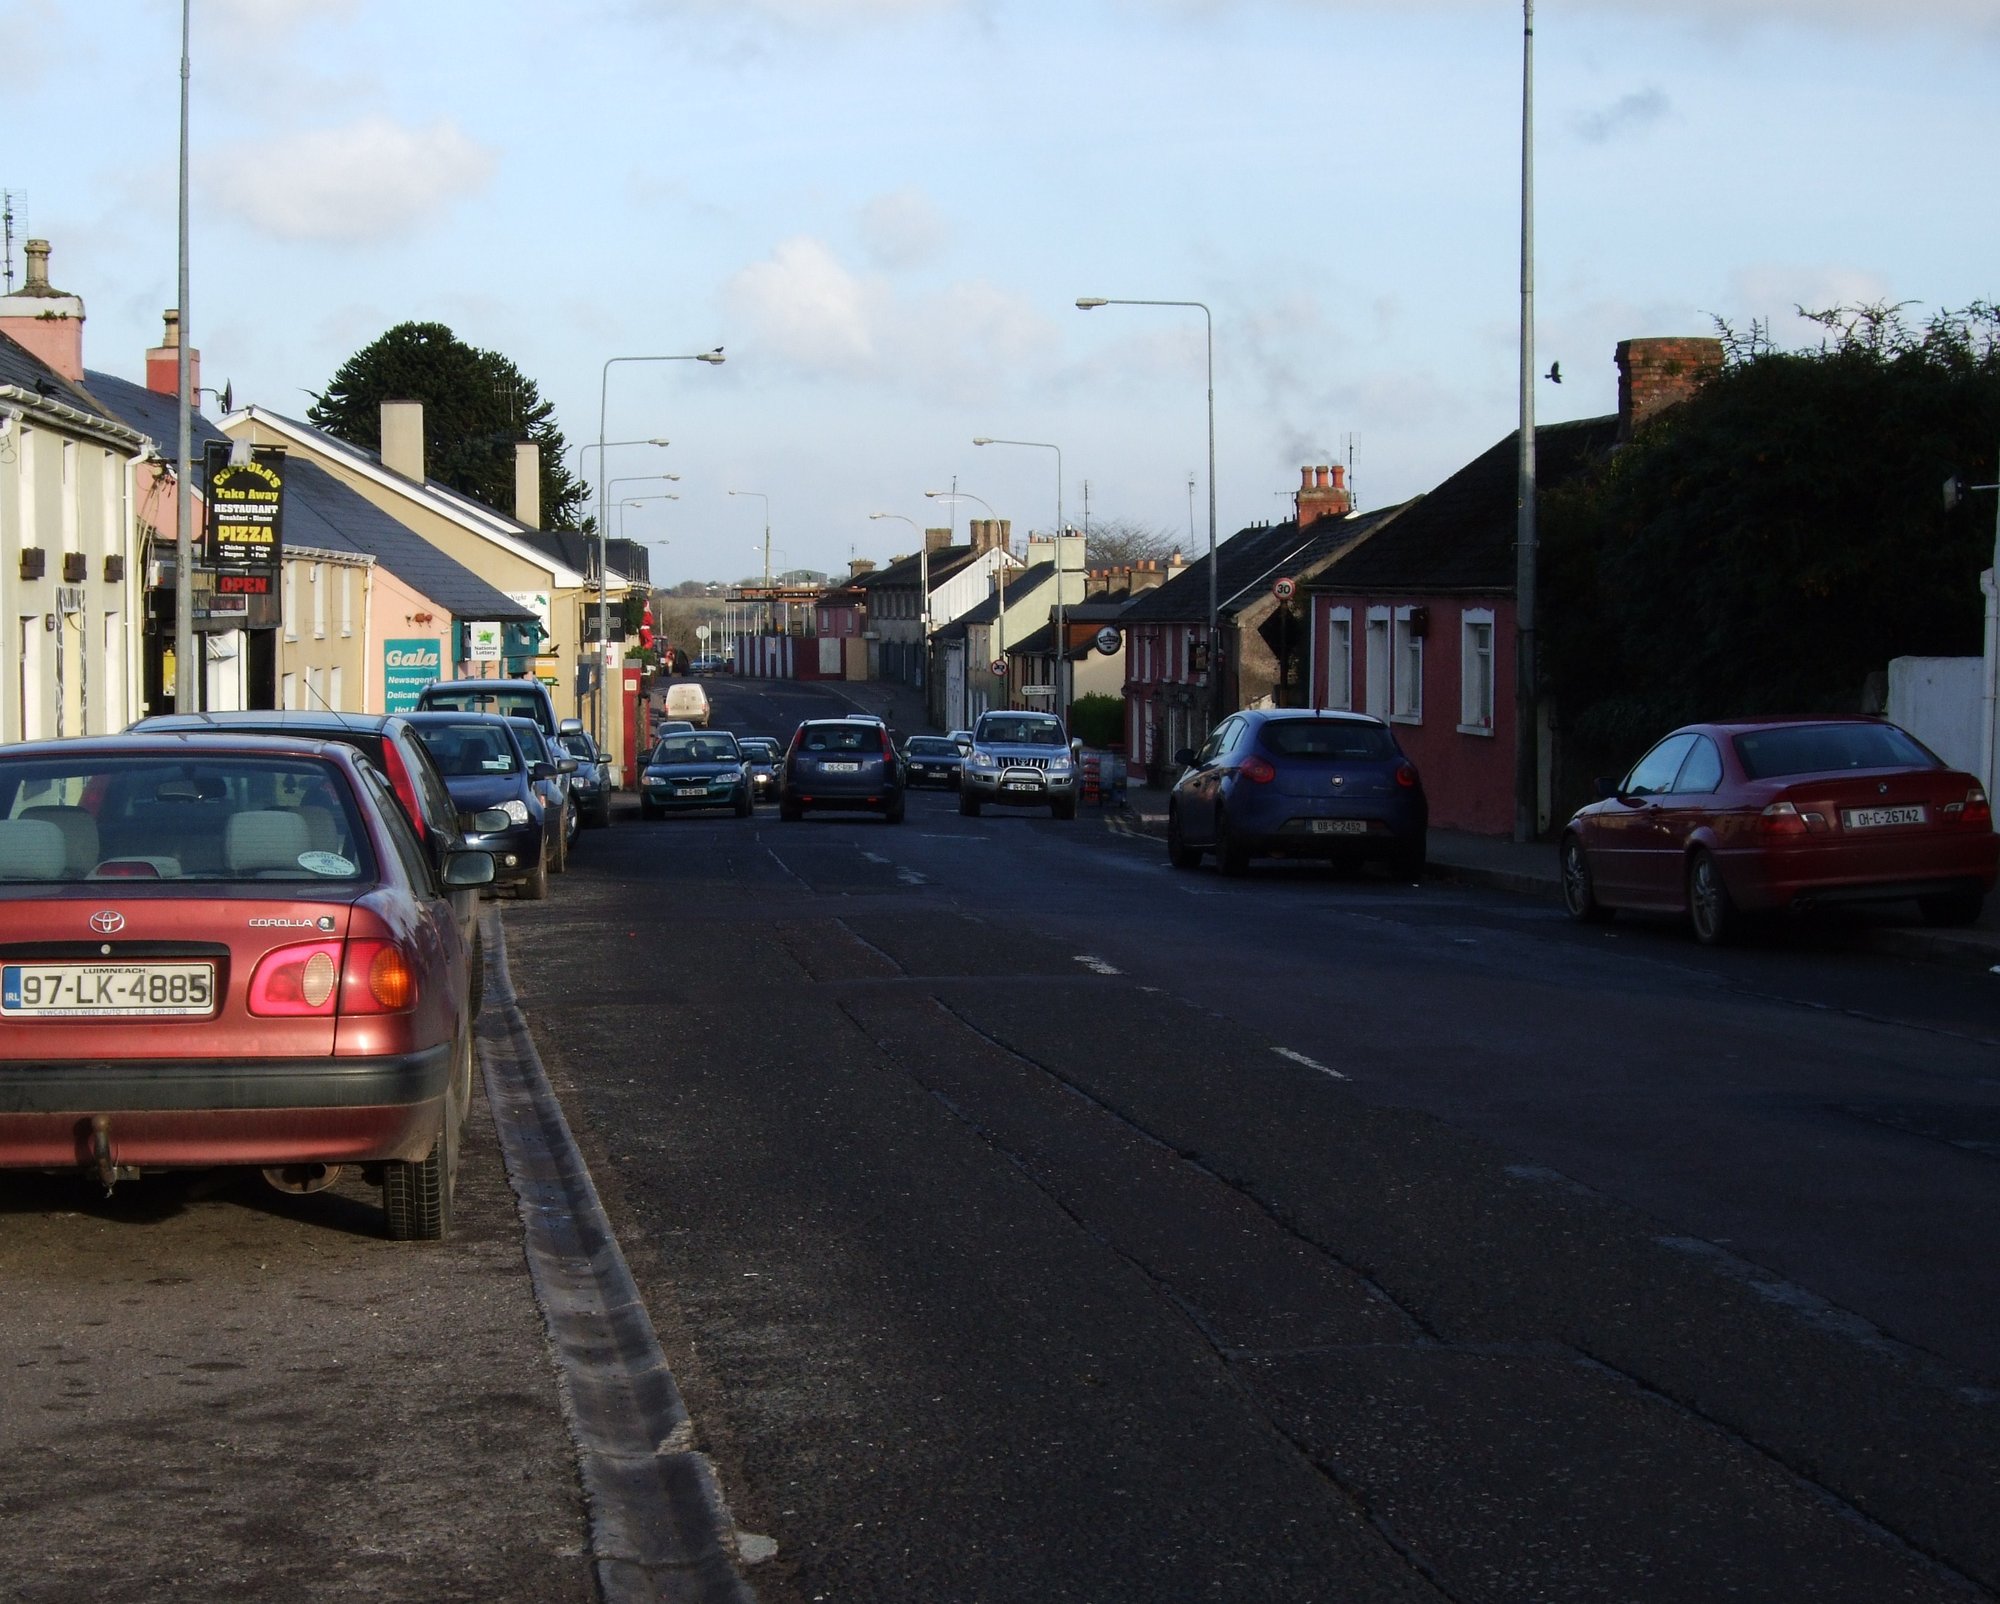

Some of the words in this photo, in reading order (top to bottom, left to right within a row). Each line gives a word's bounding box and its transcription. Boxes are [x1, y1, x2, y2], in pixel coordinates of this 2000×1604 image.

[216, 488, 245, 499] Take
[248, 489, 279, 502] Away
[214, 504, 279, 514] RESTAURANT
[218, 526, 273, 542] PIZZA
[221, 577, 267, 592] OPEN
[1277, 584, 1291, 594] 30
[386, 648, 438, 667] Gala
[387, 691, 420, 699] Delicate
[1858, 809, 1919, 826] 01-C-26742
[249, 919, 313, 927] COROLLA
[5, 993, 20, 1002] IRL
[23, 974, 207, 1005] 97-LK-4885
